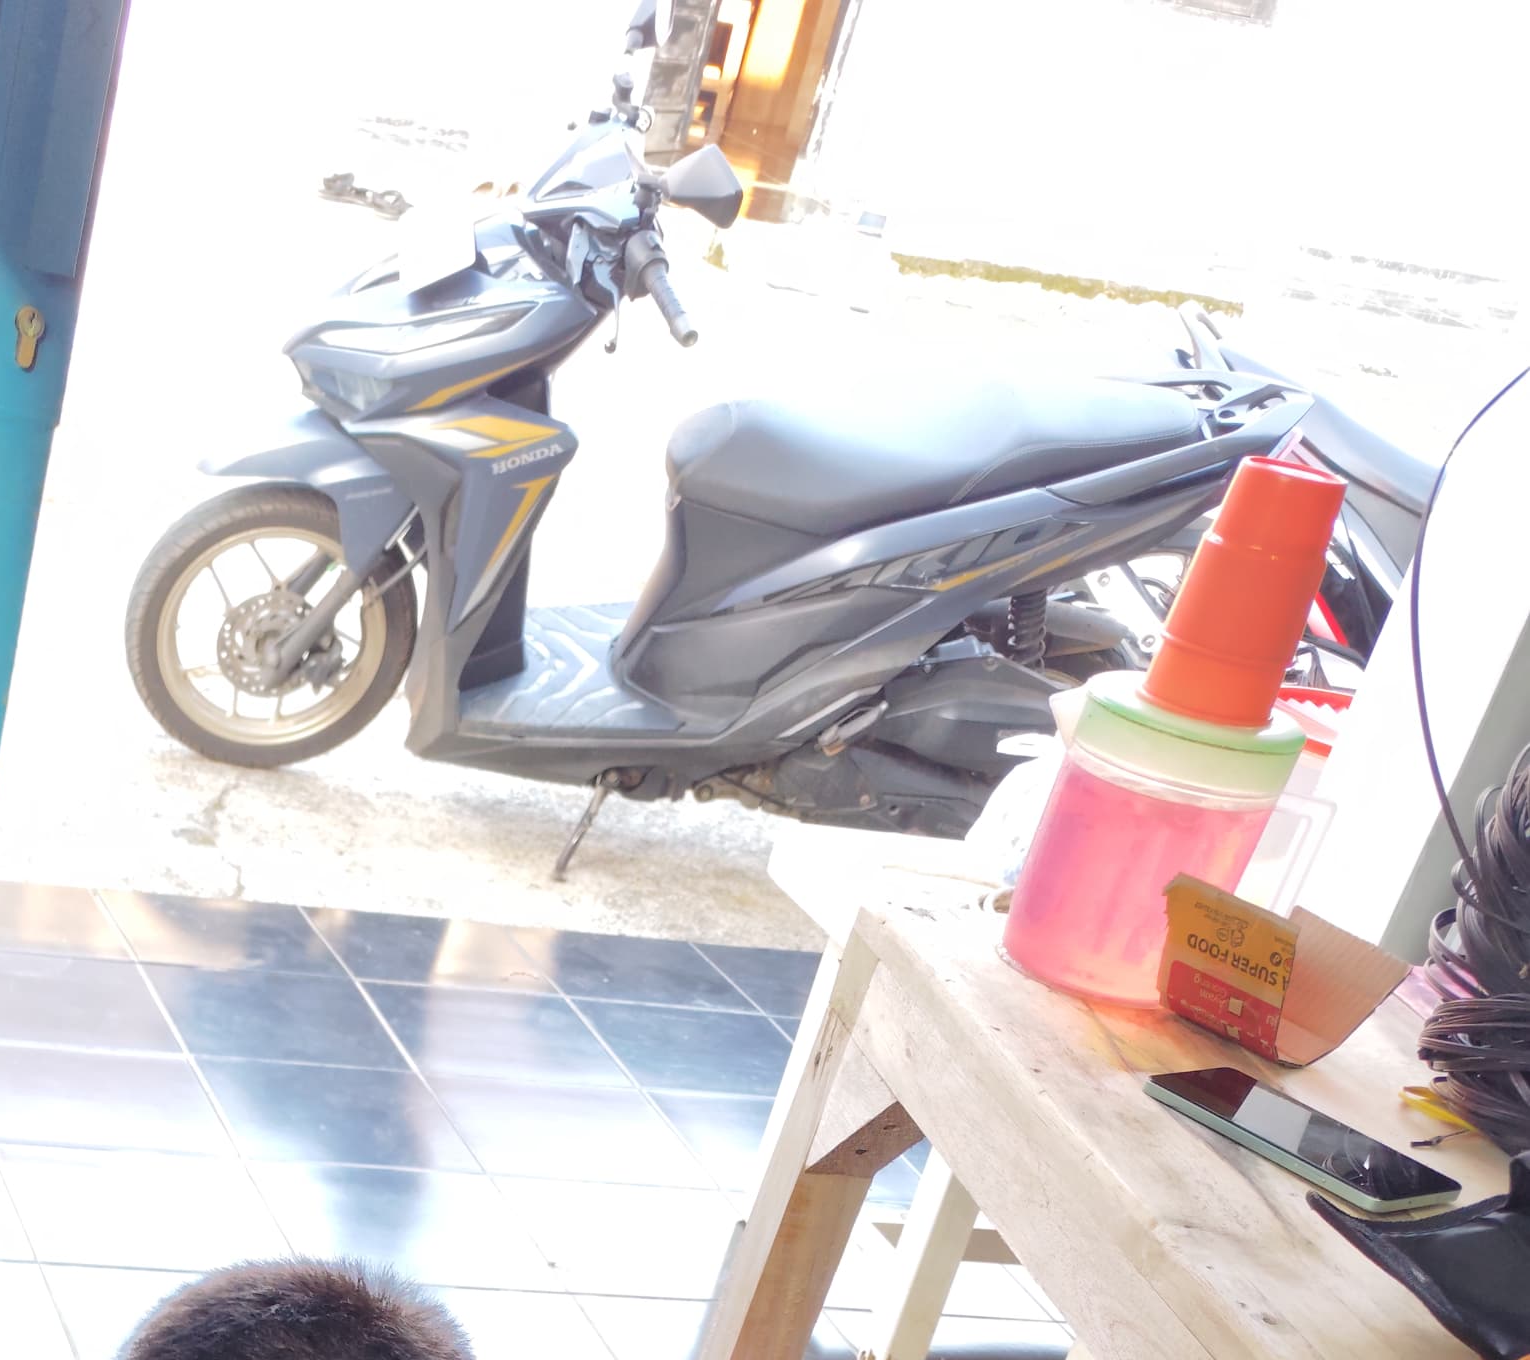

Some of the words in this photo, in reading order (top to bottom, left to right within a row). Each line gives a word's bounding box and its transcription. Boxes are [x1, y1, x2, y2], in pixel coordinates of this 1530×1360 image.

[491, 443, 566, 475] HONDA
[1187, 933, 1230, 963] FOOD
[1230, 952, 1279, 987] SUPER
